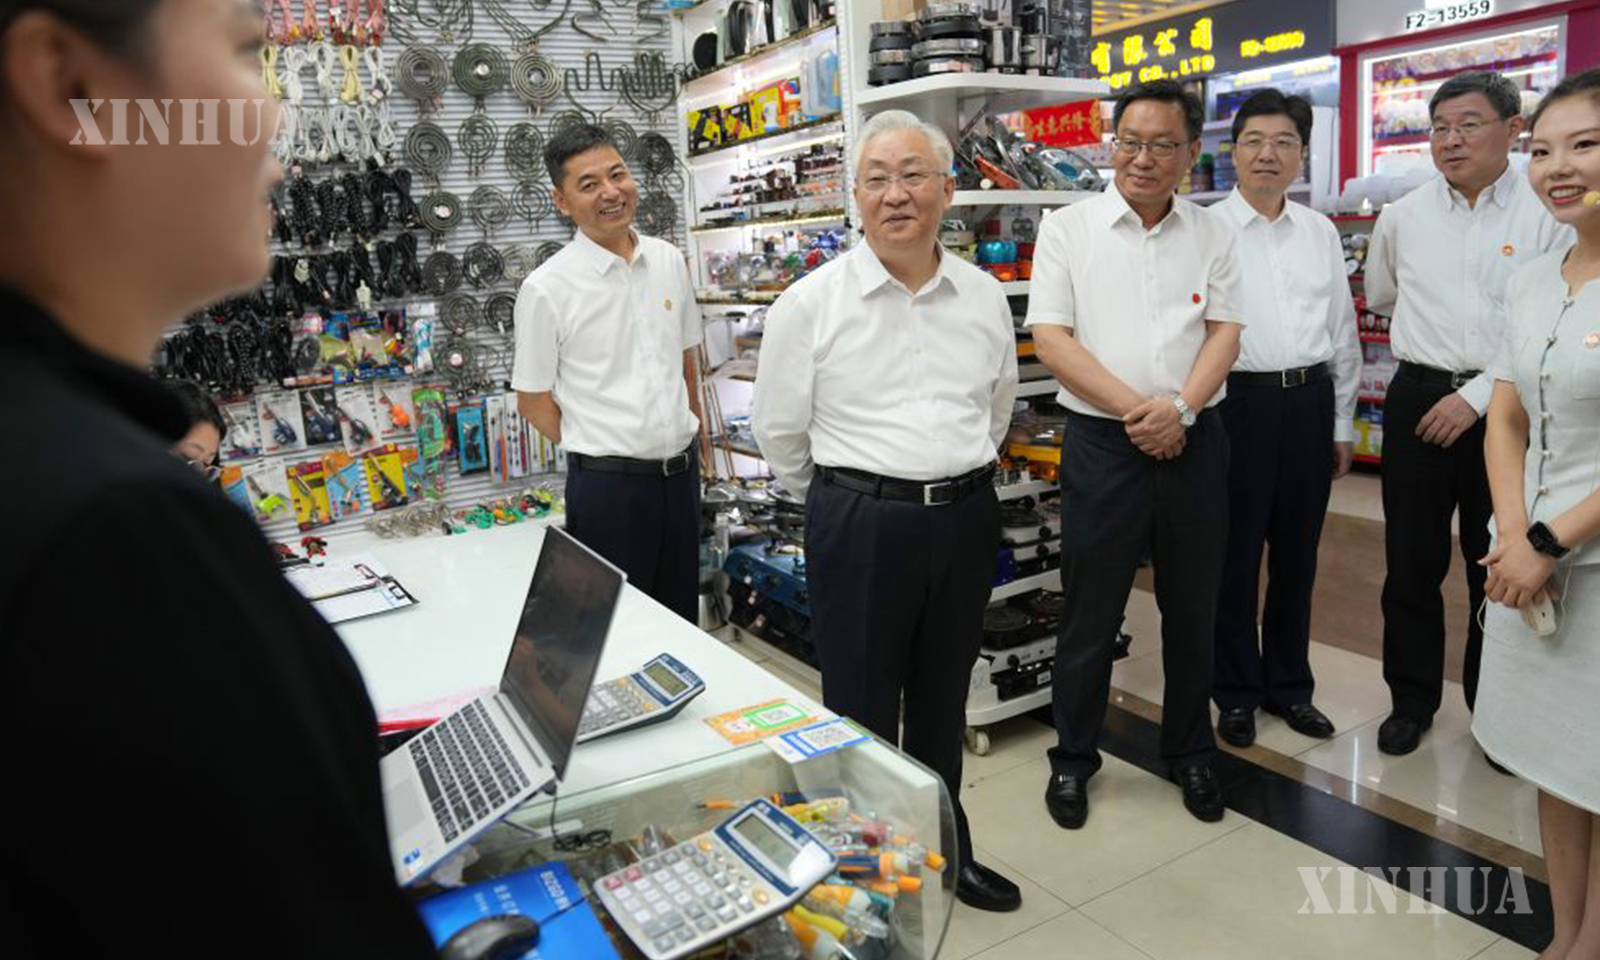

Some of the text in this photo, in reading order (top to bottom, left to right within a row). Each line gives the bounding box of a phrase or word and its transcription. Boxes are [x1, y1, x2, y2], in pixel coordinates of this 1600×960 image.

[1405, 0, 1490, 29] F2-13559
[1091, 17, 1213, 74] 有限公司
